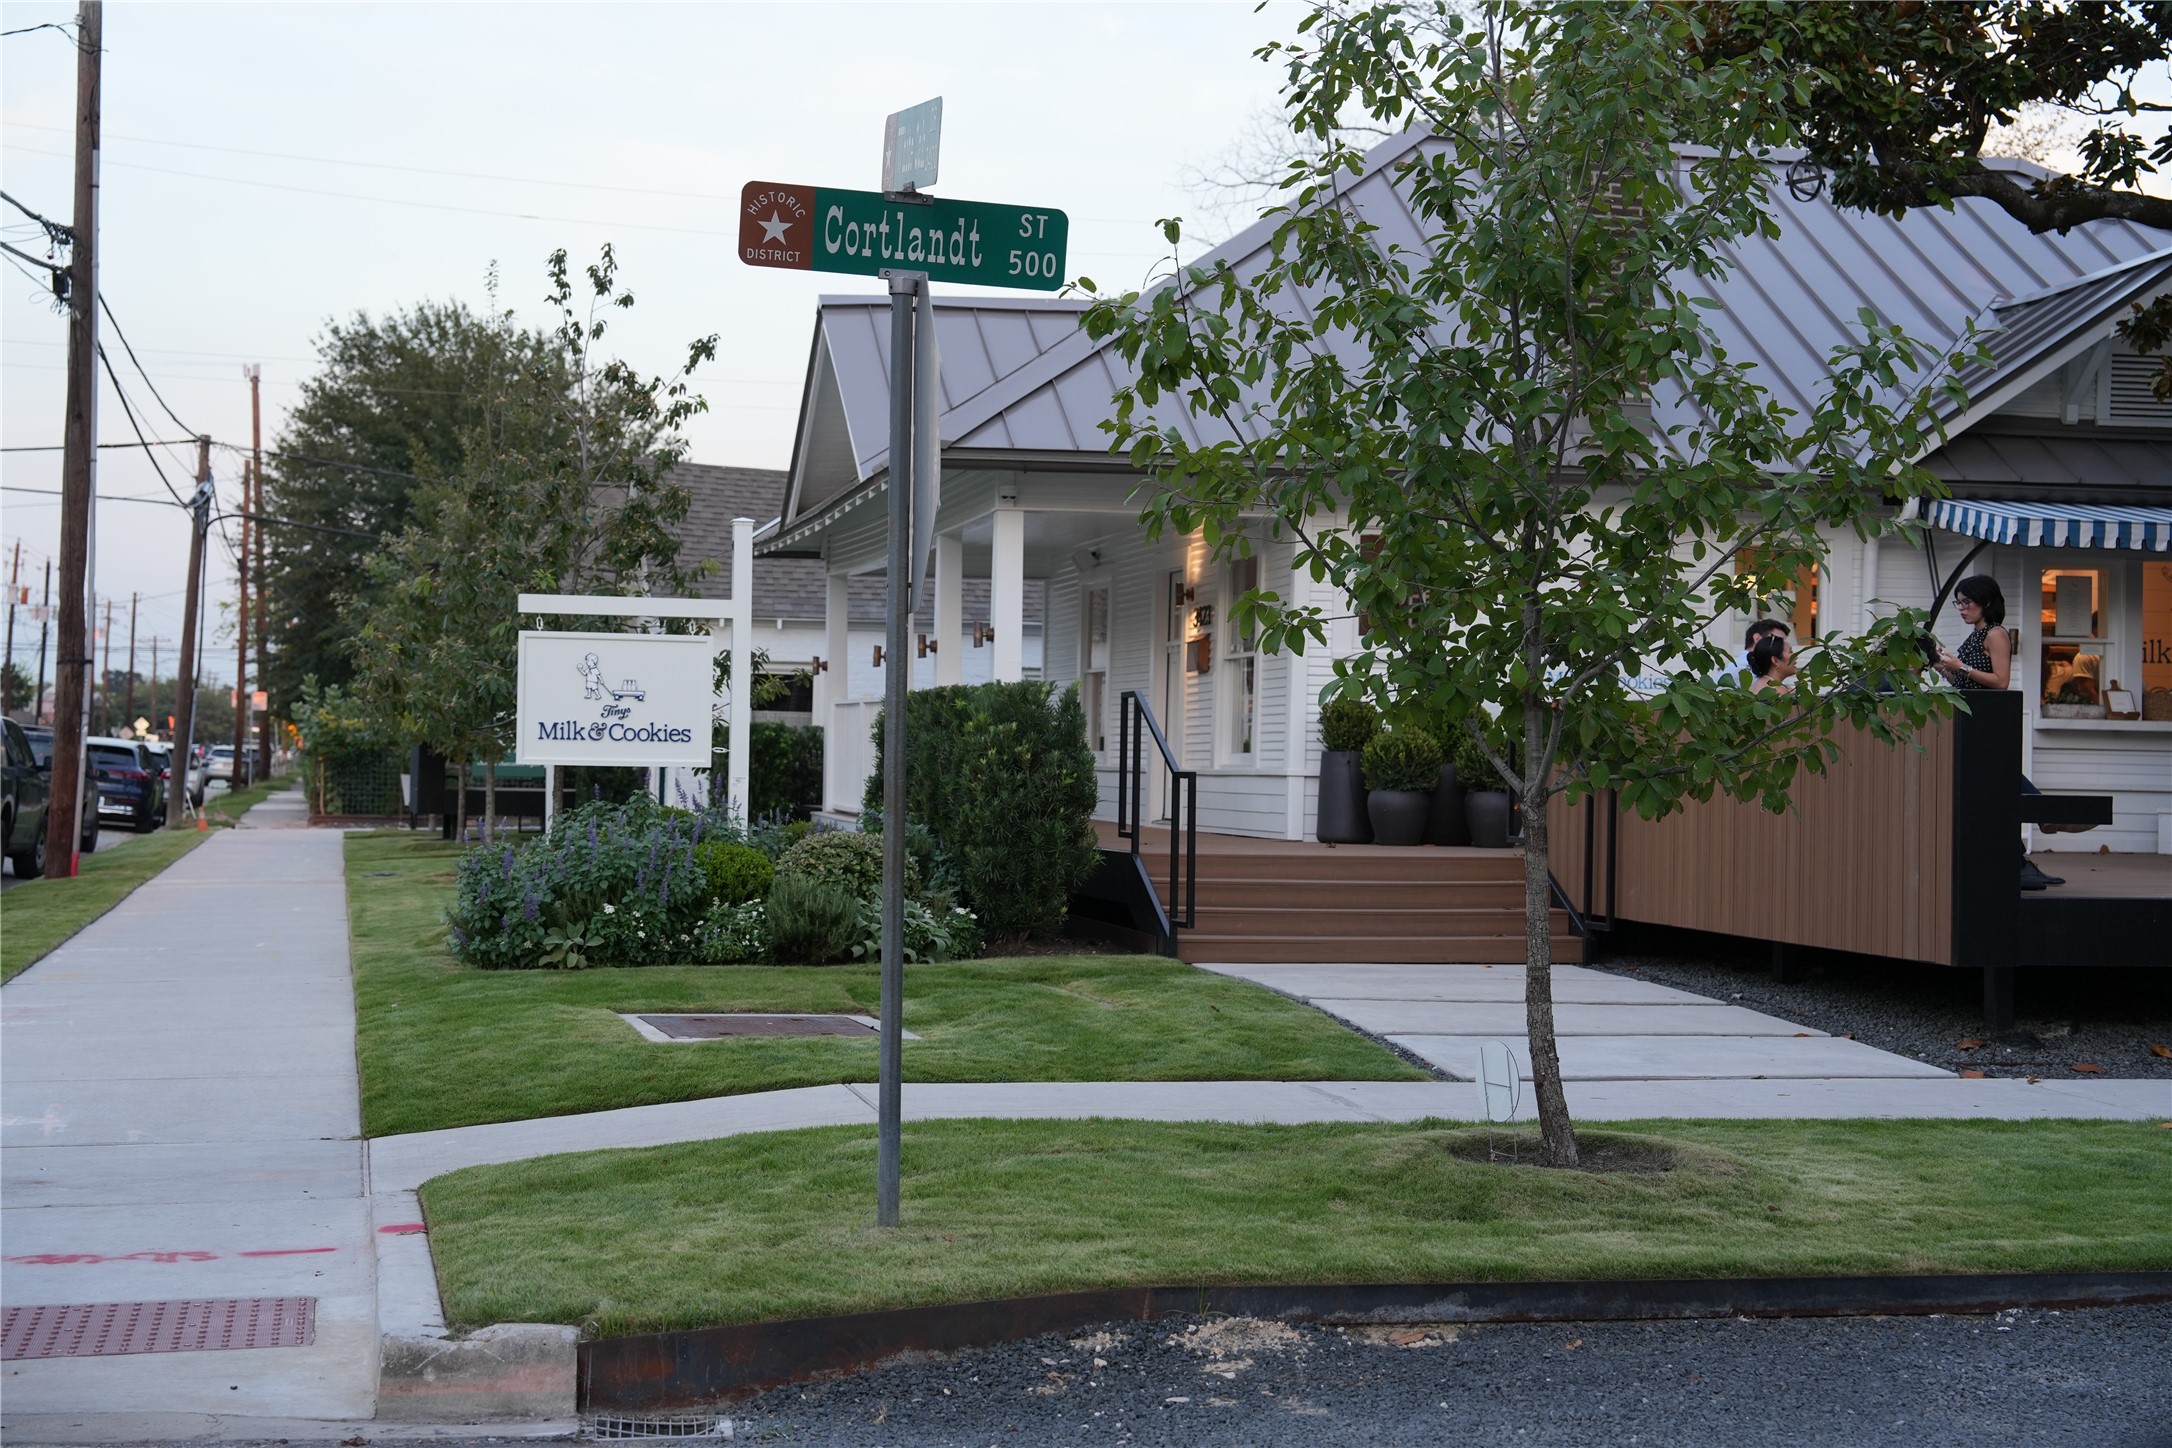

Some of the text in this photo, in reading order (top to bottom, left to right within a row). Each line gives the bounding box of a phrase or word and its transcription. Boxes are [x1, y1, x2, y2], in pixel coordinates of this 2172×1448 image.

[747, 191, 806, 218] HISTORIC
[824, 205, 1049, 268] Cortlandt ST
[746, 248, 800, 262] DISTRICT
[1008, 250, 1057, 278] 500
[538, 721, 586, 741] Milk
[609, 722, 692, 743] Cookies
